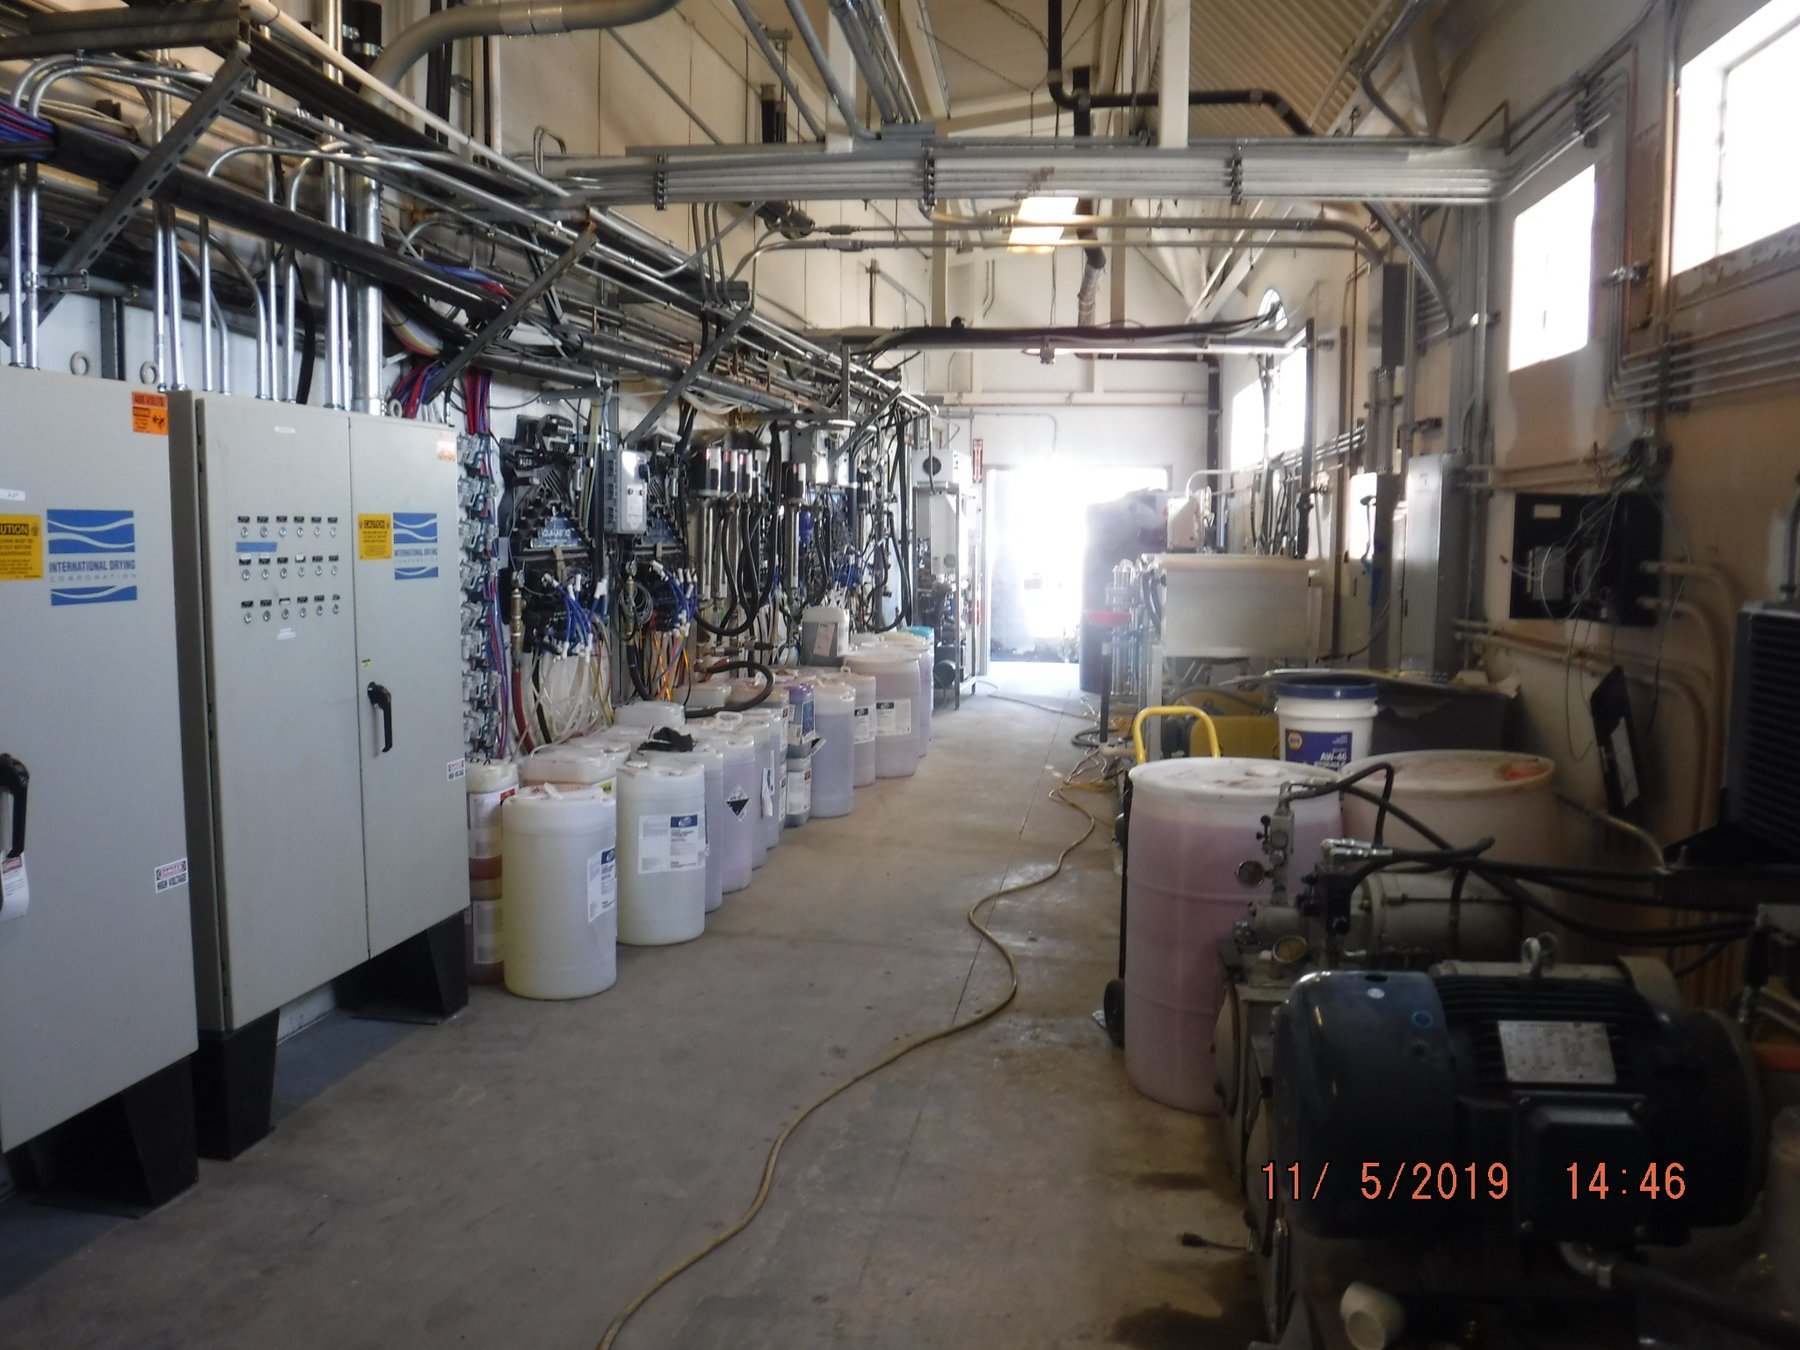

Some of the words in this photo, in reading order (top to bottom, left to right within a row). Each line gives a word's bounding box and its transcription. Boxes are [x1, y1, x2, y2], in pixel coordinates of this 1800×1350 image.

[0, 523, 29, 535] UTION
[49, 561, 107, 573] INTERNATIONAL
[109, 559, 136, 571] DRYING
[169, 872, 187, 886] VOLTAGE
